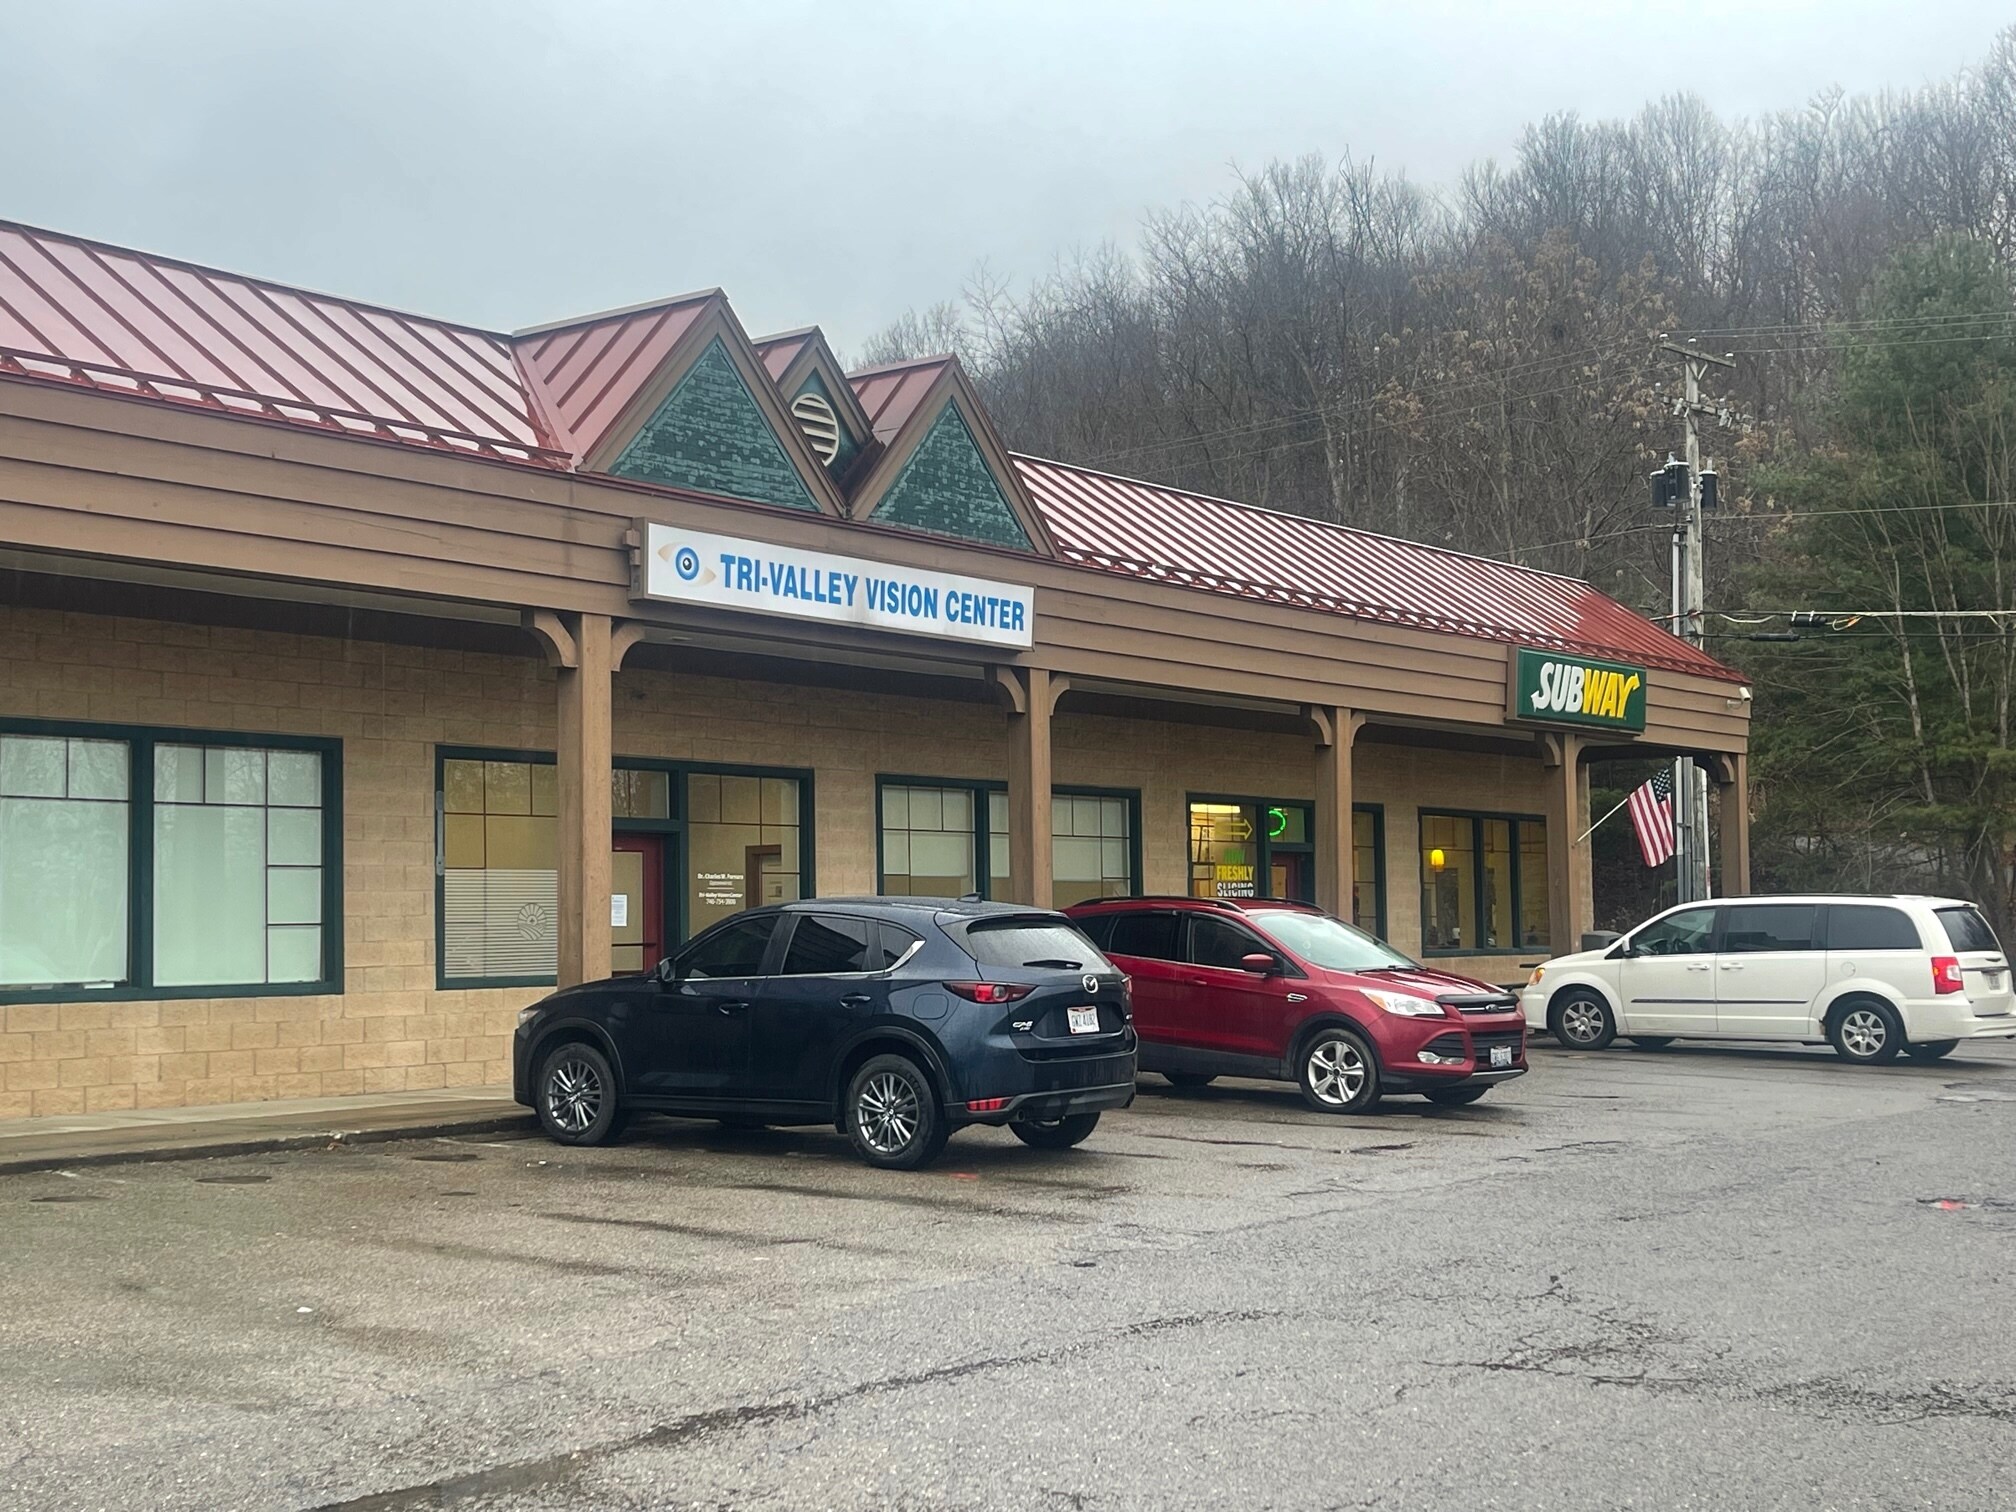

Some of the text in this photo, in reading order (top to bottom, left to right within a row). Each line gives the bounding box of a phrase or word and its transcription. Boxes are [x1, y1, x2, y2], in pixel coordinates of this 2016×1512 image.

[720, 553, 1024, 631] TRI-VALLEY VISION CENTER
[1531, 662, 1640, 719] SUBWAY
[1216, 865, 1254, 881] FRESHLY
[1217, 882, 1254, 897] SLICING
